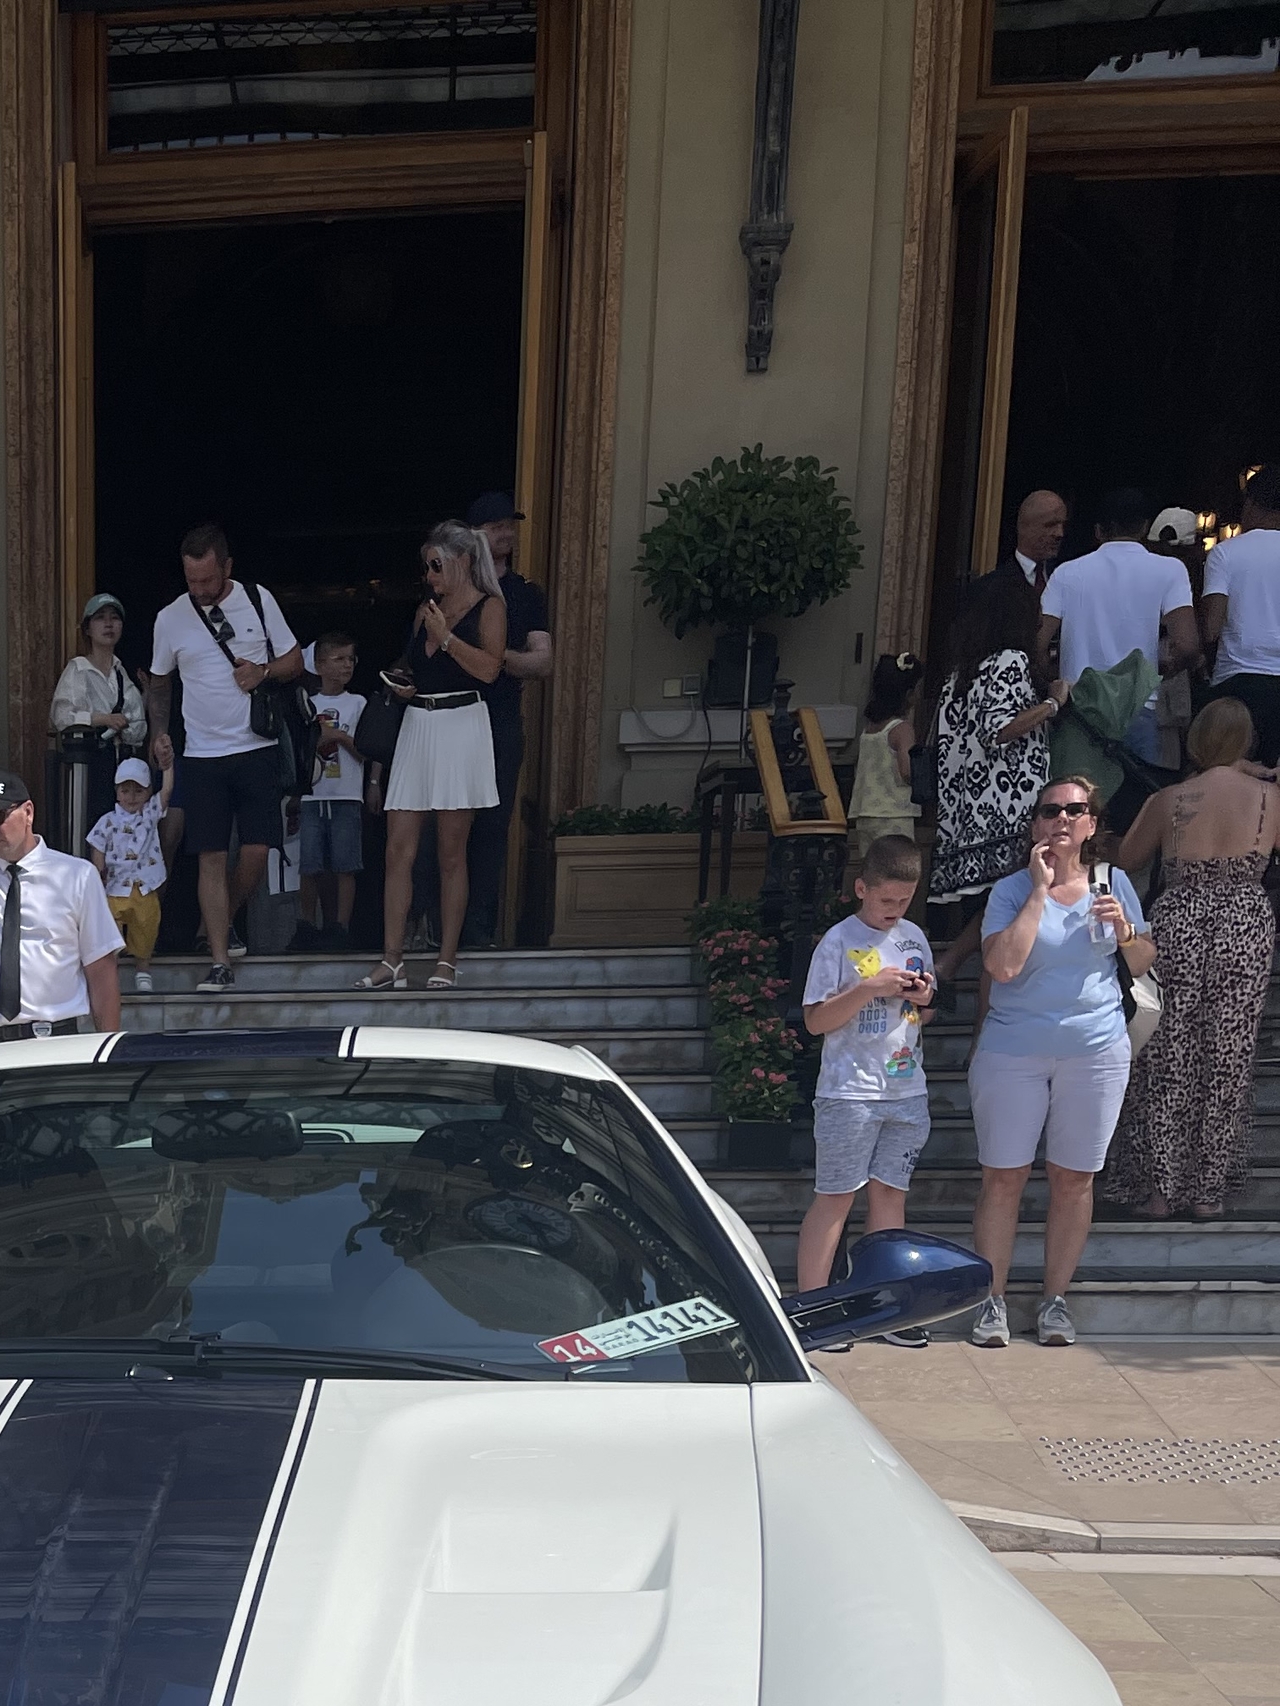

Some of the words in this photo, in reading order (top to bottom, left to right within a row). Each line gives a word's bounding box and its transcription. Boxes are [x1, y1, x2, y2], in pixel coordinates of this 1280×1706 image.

[859, 1008, 888, 1022] 0003
[858, 1020, 887, 1034] 0009
[553, 1339, 598, 1363] 14
[627, 1302, 727, 1342] 14141
